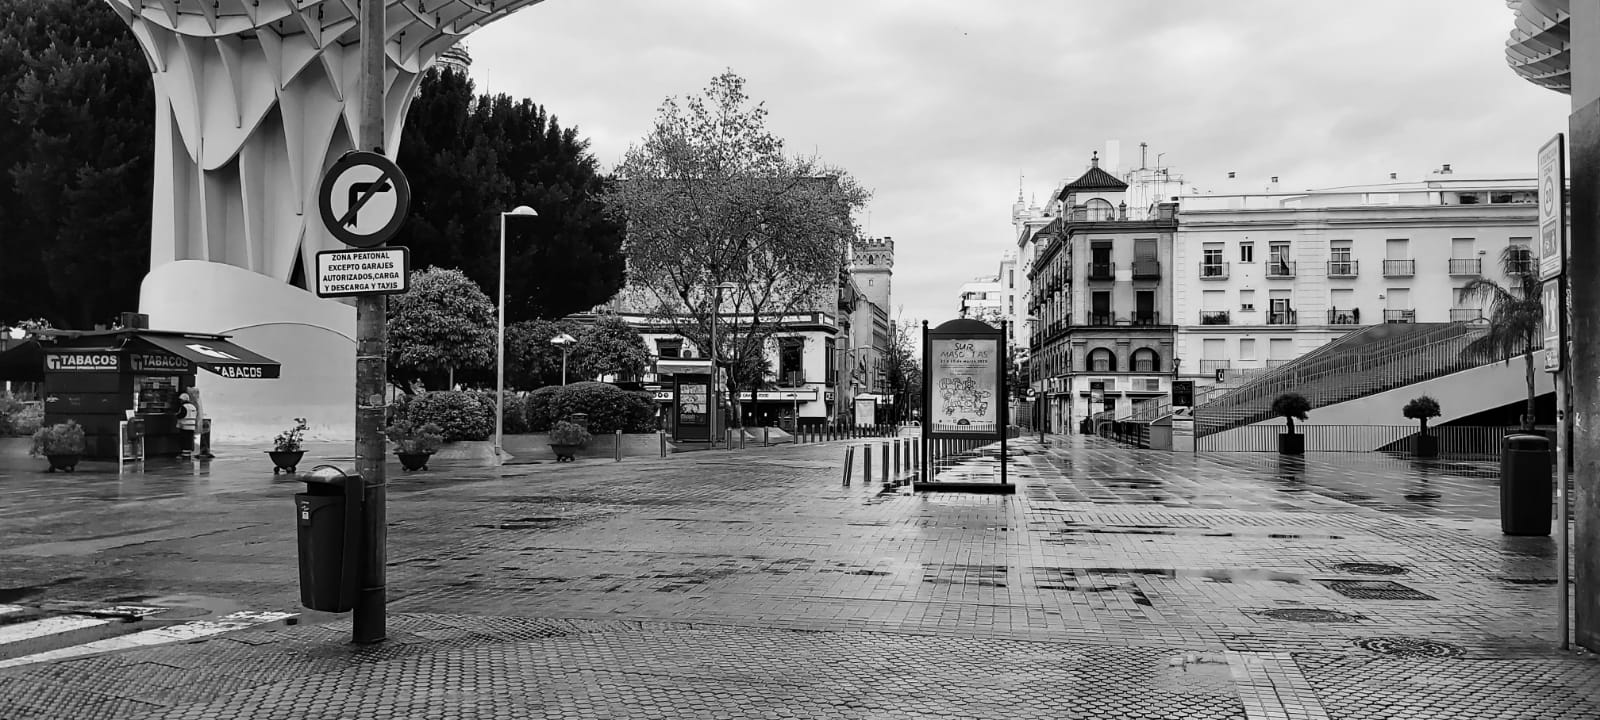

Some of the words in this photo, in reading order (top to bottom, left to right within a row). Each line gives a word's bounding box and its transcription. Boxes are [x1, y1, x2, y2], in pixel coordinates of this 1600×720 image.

[353, 252, 390, 260] PEATONAL
[328, 263, 360, 272] EXCEPTO
[361, 262, 394, 270] GARAJES
[331, 283, 370, 291] DESCARGA
[954, 342, 974, 351] SUR
[940, 350, 988, 358] MASCTAS
[60, 355, 117, 365] TABACOS
[142, 354, 188, 367] TABACOS
